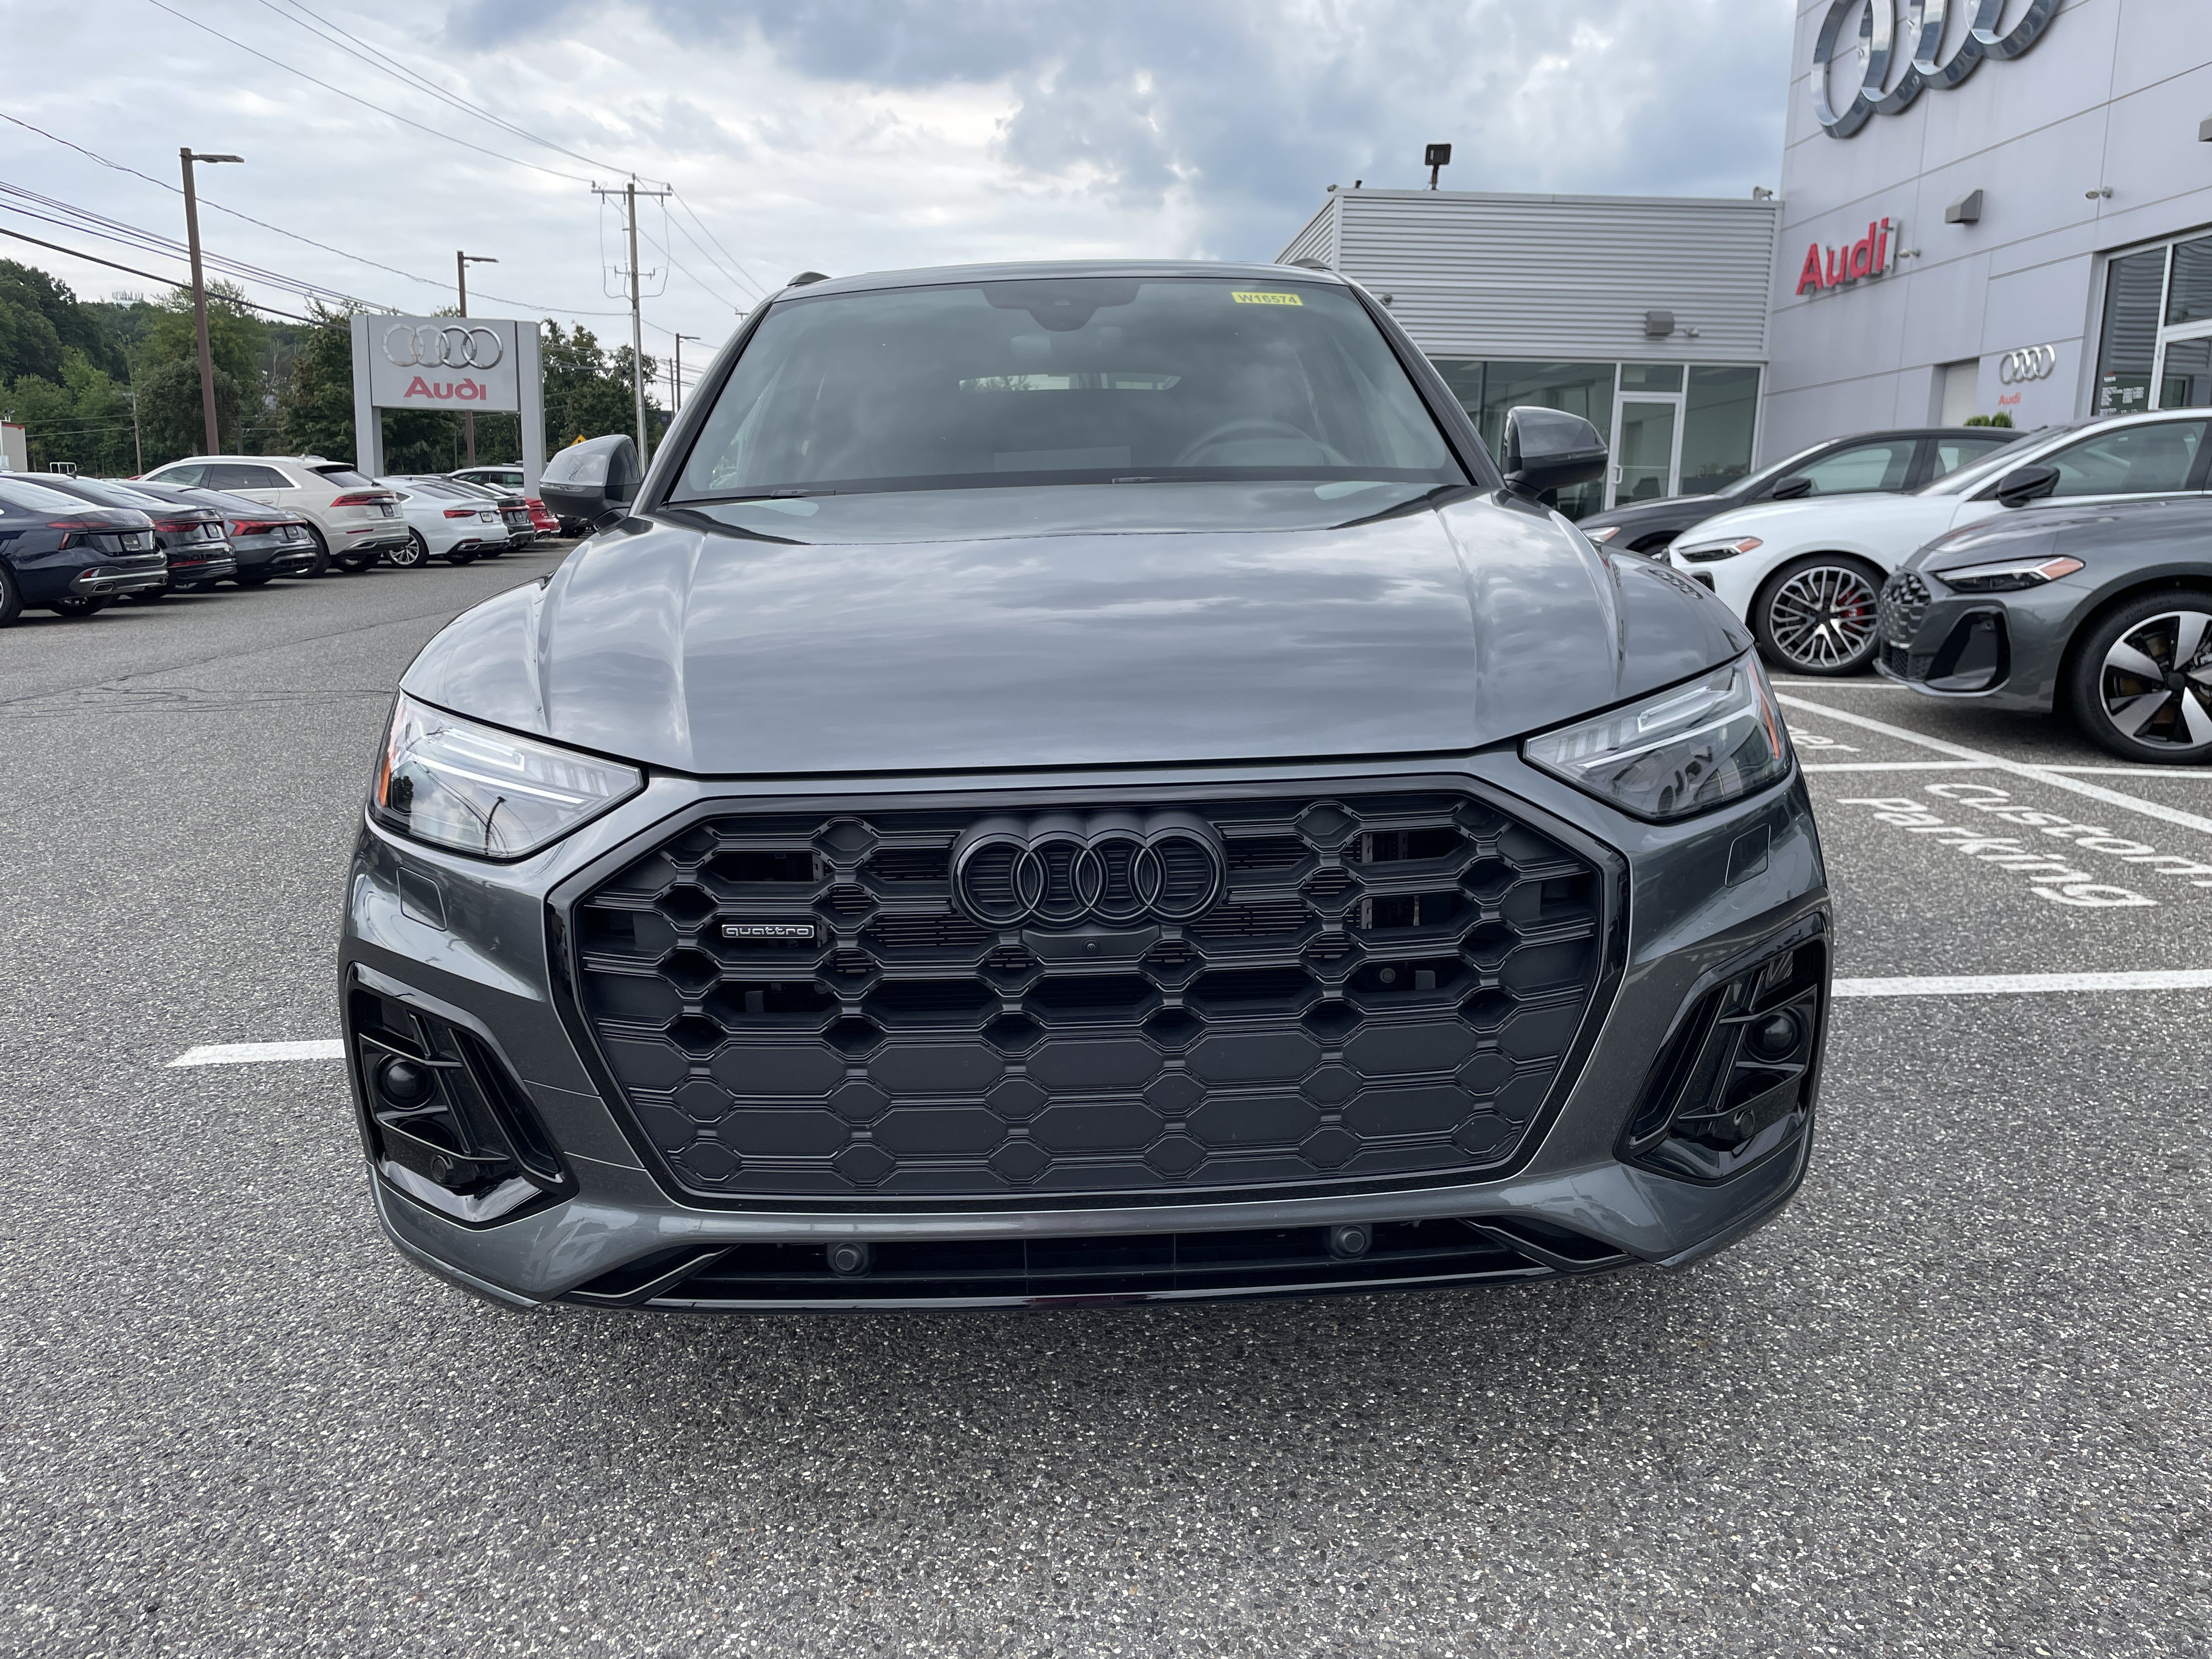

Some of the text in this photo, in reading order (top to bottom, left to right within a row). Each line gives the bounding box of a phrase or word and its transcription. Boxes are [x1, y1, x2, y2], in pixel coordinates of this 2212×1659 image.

[1796, 217, 1889, 295] Audi
[1238, 294, 1297, 304] W16574
[403, 376, 487, 400] Audi
[1997, 392, 2021, 406] Audi
[1836, 797, 2159, 907] Parking
[726, 927, 809, 936] quattro
